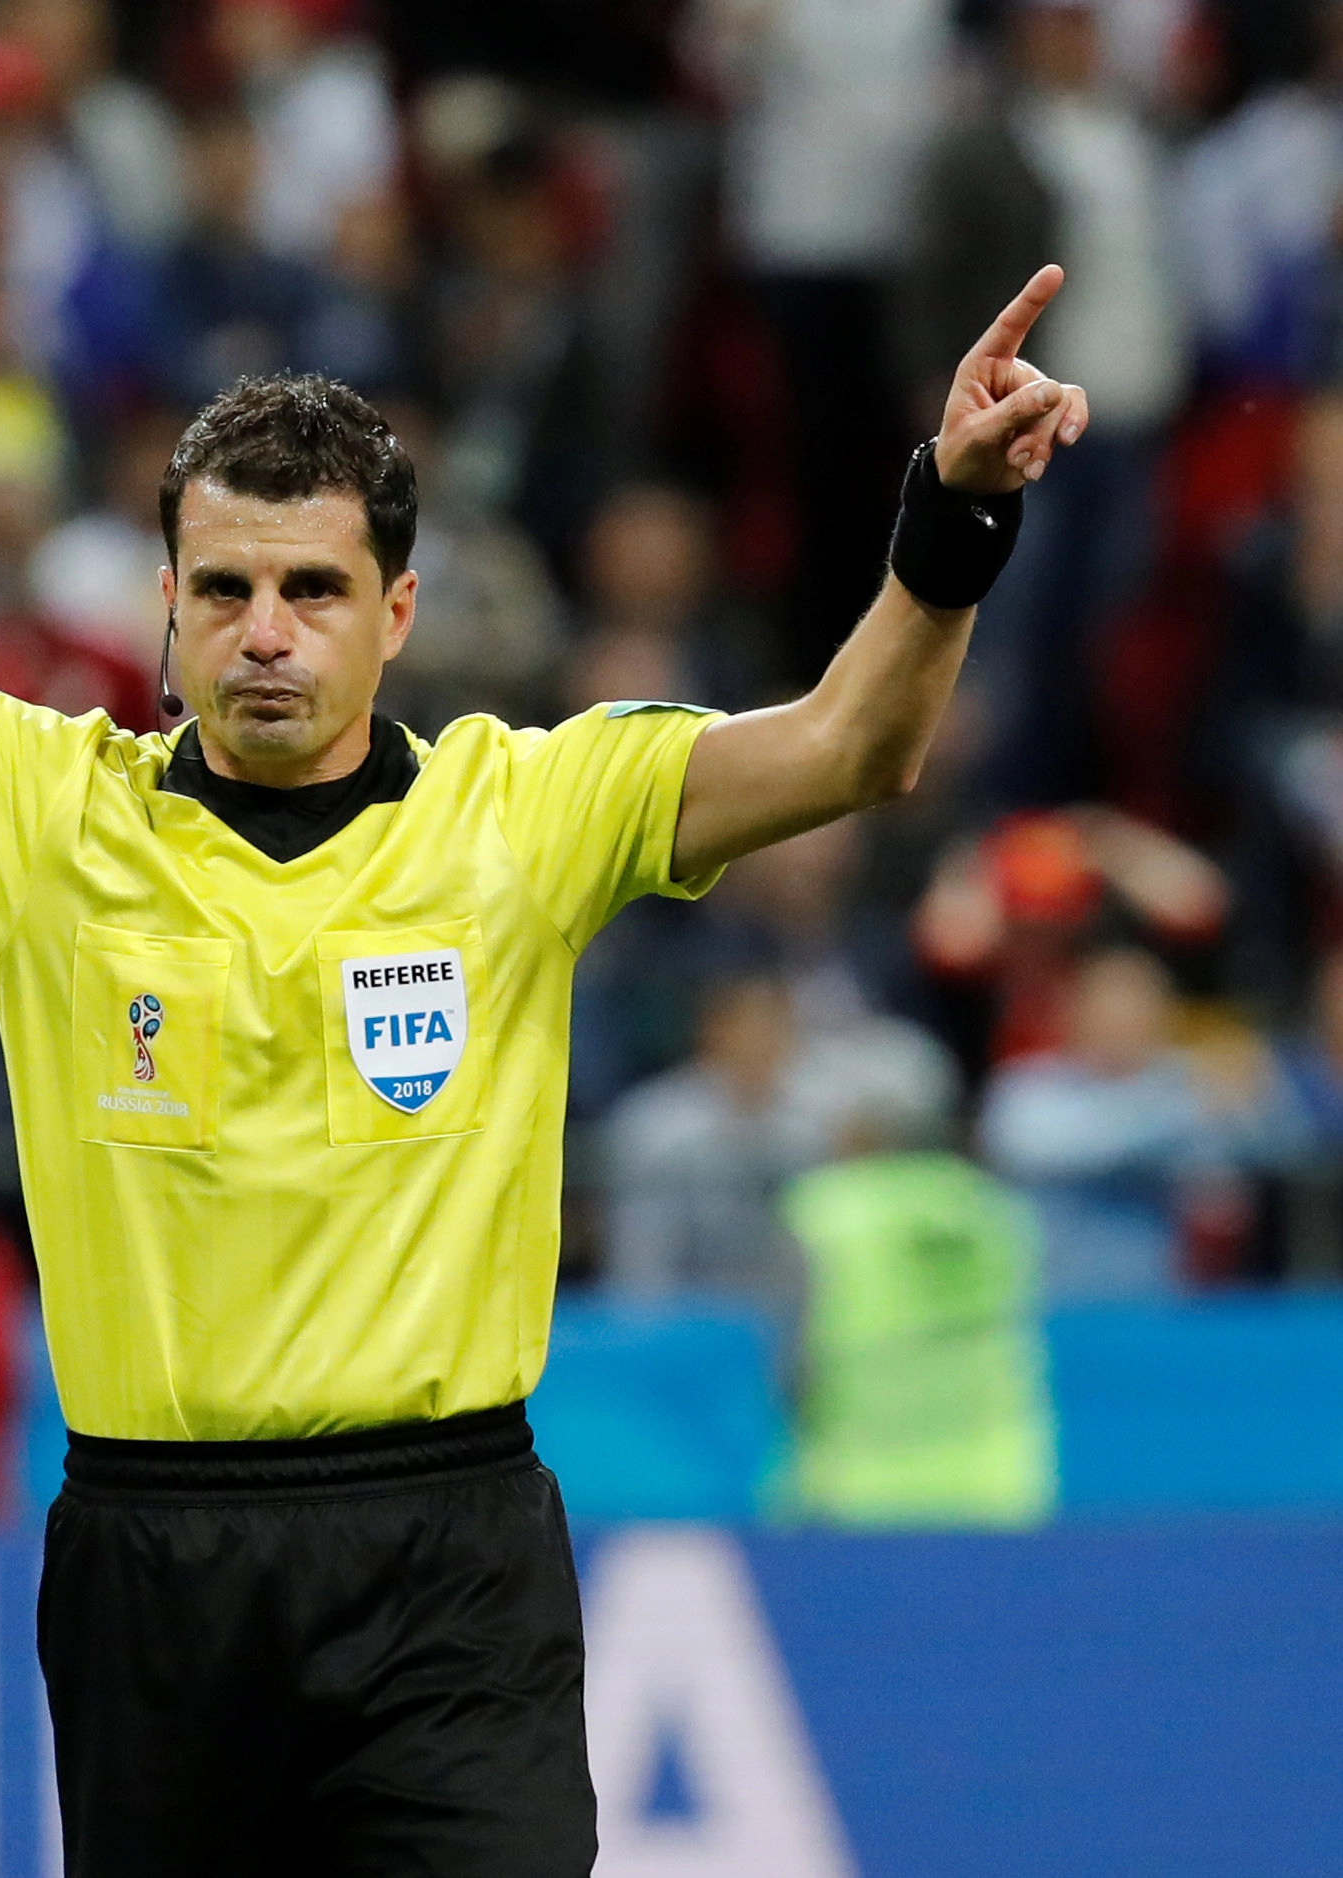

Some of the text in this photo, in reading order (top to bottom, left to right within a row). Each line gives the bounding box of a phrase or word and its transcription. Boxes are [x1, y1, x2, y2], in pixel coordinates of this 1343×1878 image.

[352, 961, 455, 990] REFEREE
[363, 1010, 454, 1050] FIFA
[392, 1079, 433, 1099] 2018
[97, 1093, 190, 1117] RUSSIA 2018
